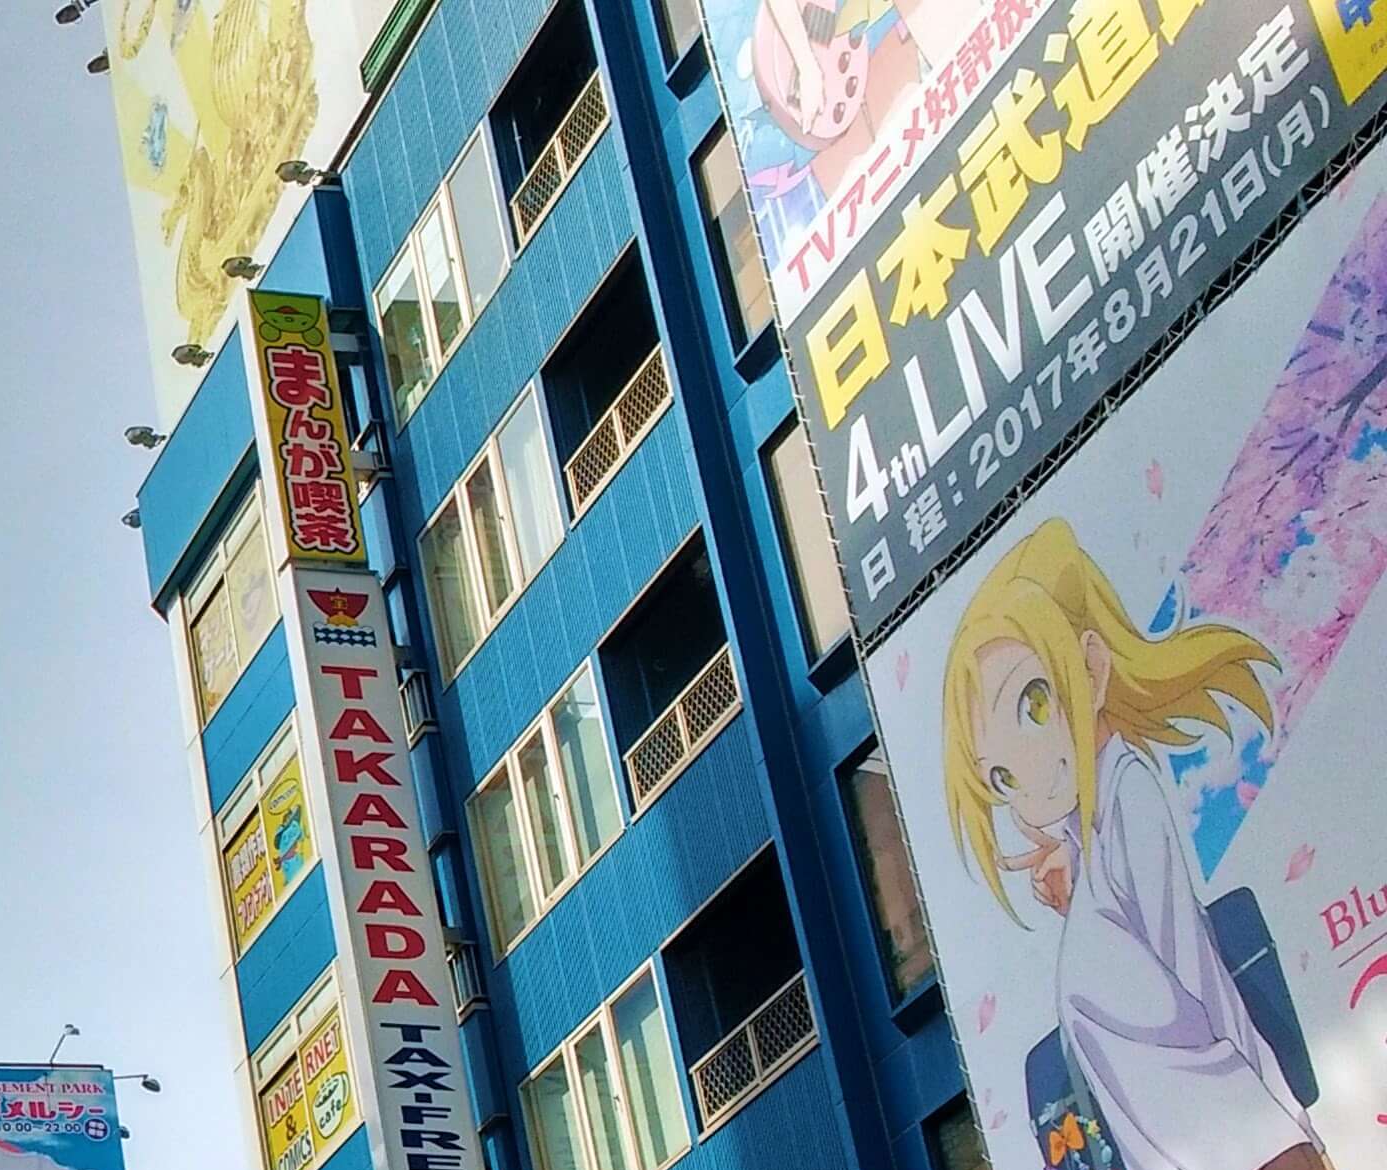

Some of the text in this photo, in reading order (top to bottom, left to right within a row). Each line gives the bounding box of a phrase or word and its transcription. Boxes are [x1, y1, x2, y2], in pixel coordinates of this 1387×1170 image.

[805, 0, 1211, 432] 日本武道
[846, 4, 1311, 525] 4th LIVE 開催決定
[269, 346, 355, 553] まんが喫茶
[320, 665, 439, 1007] TAKARADA
[60, 1082, 105, 1096] PARK
[267, 1022, 342, 1128] INTERNET
[285, 1113, 298, 1142] &
[318, 1098, 347, 1131] cafe
